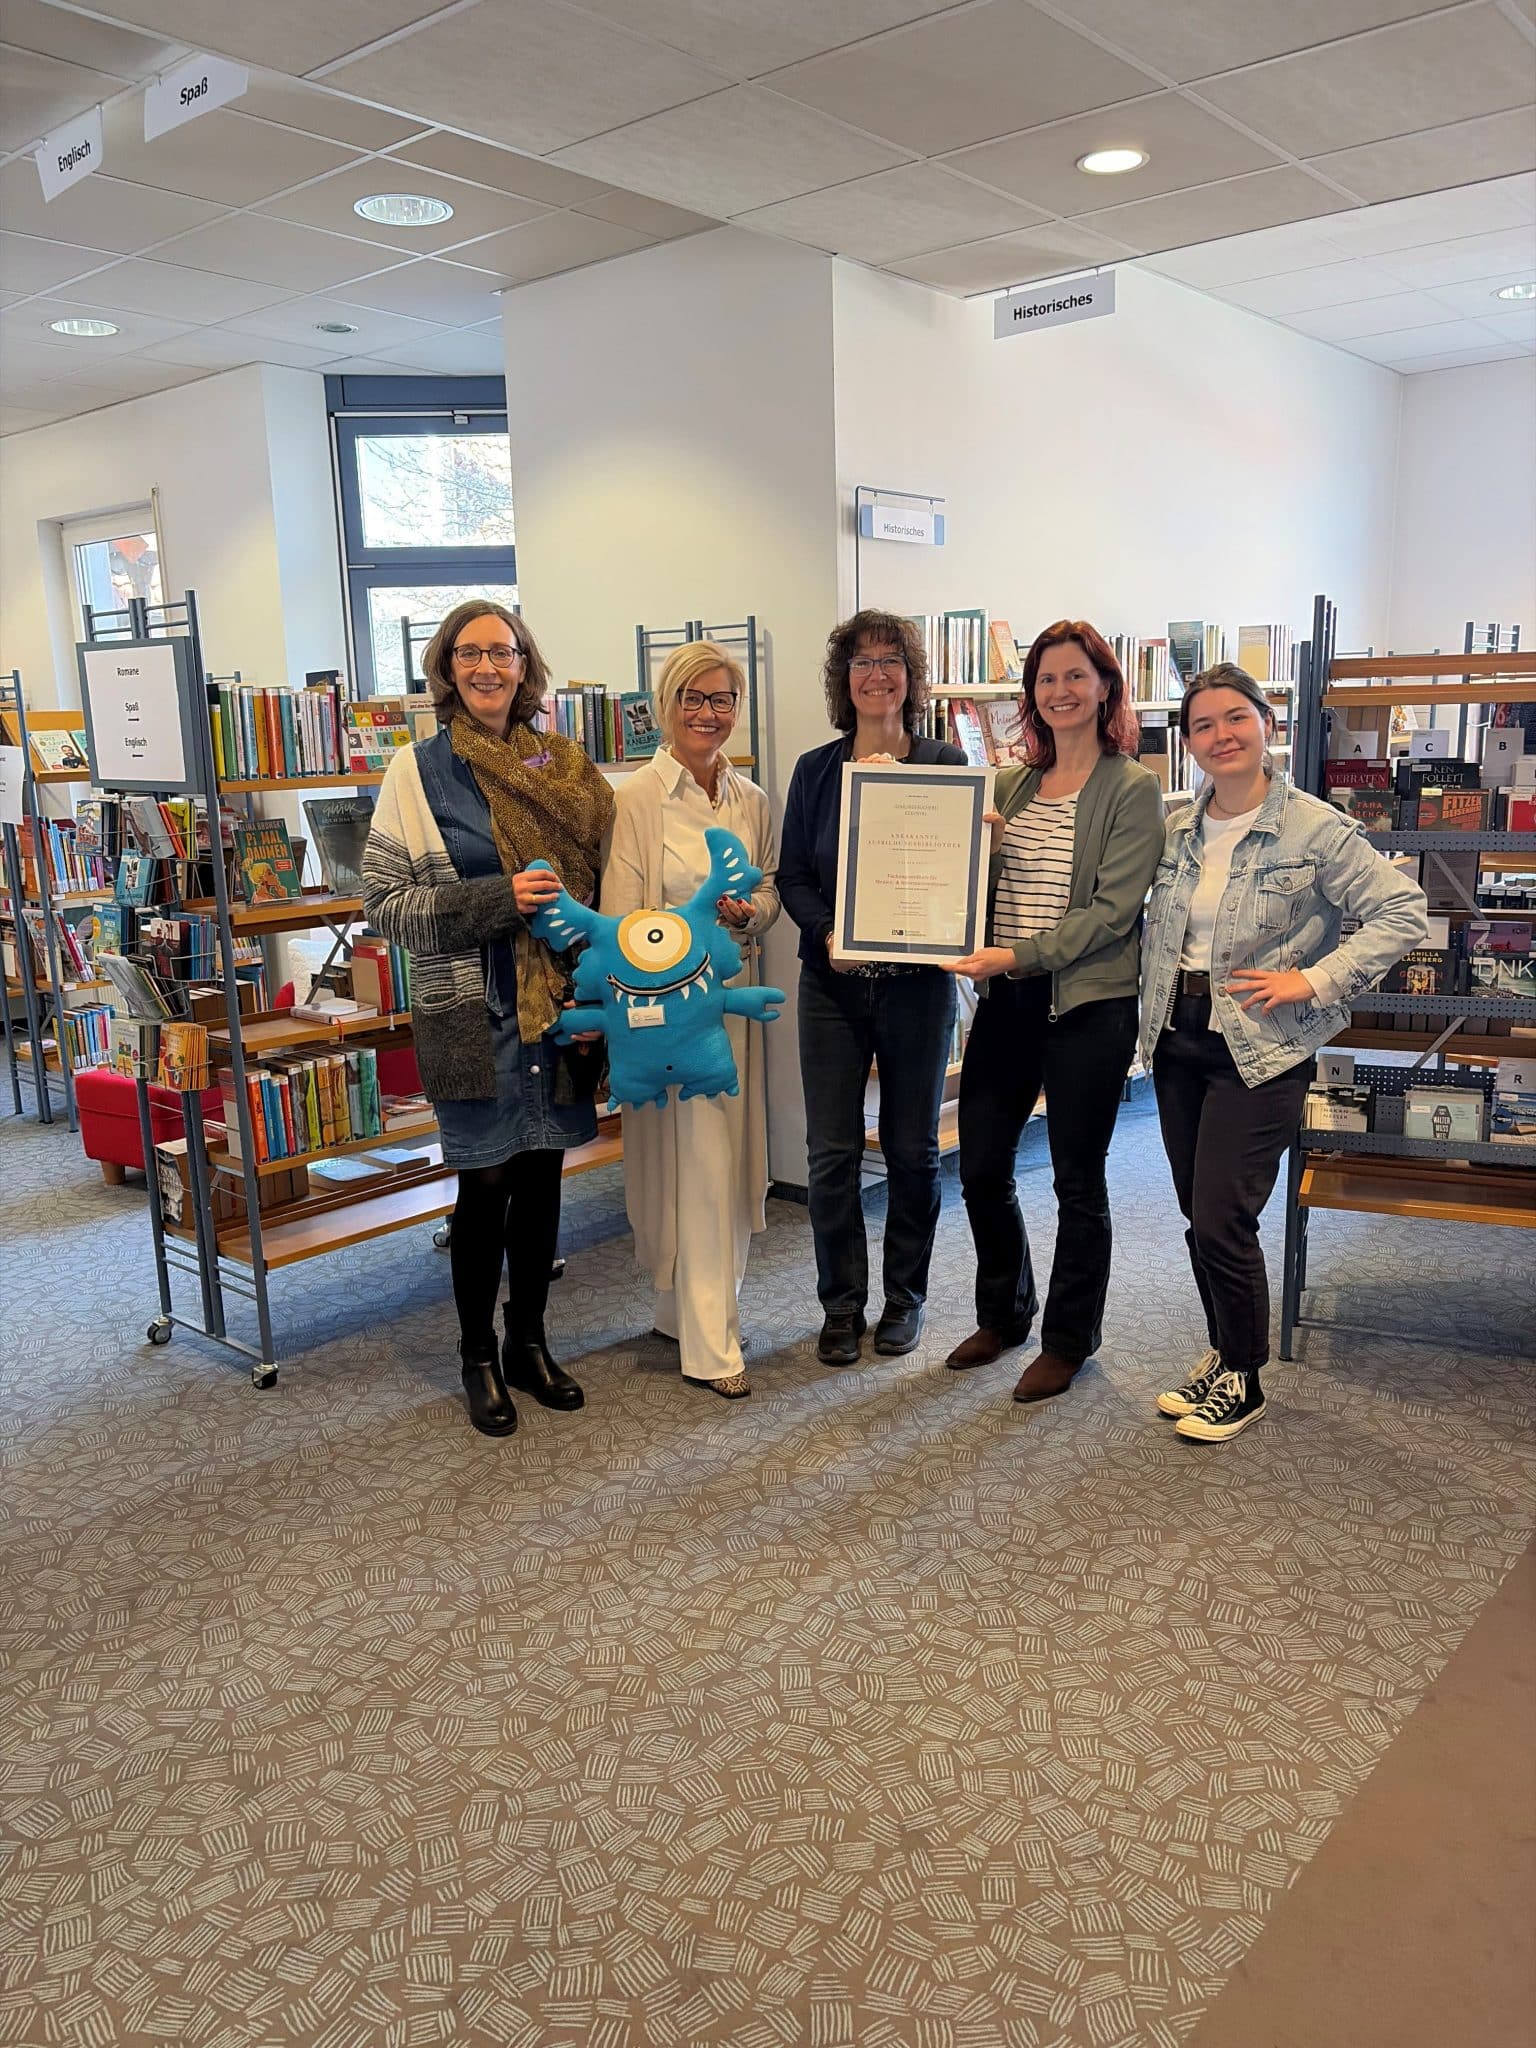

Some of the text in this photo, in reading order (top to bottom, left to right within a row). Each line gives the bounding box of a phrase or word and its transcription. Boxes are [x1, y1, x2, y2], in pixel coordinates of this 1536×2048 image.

[179, 76, 209, 106] Spaß
[57, 139, 92, 173] Englisch
[1013, 292, 1093, 321] Historisches
[883, 522, 925, 538] Historisches
[117, 667, 140, 677] Romane
[125, 701, 139, 714] Spaß
[125, 737, 147, 748] Englisch
[1425, 742, 1434, 752] C
[1499, 741, 1507, 750] B
[1353, 744, 1362, 754] A
[1434, 765, 1454, 774] KEN
[1328, 772, 1387, 785] VERRATEN
[1422, 773, 1464, 784] FOLLETT
[1331, 1066, 1340, 1076] N
[1513, 1074, 1523, 1085] R
